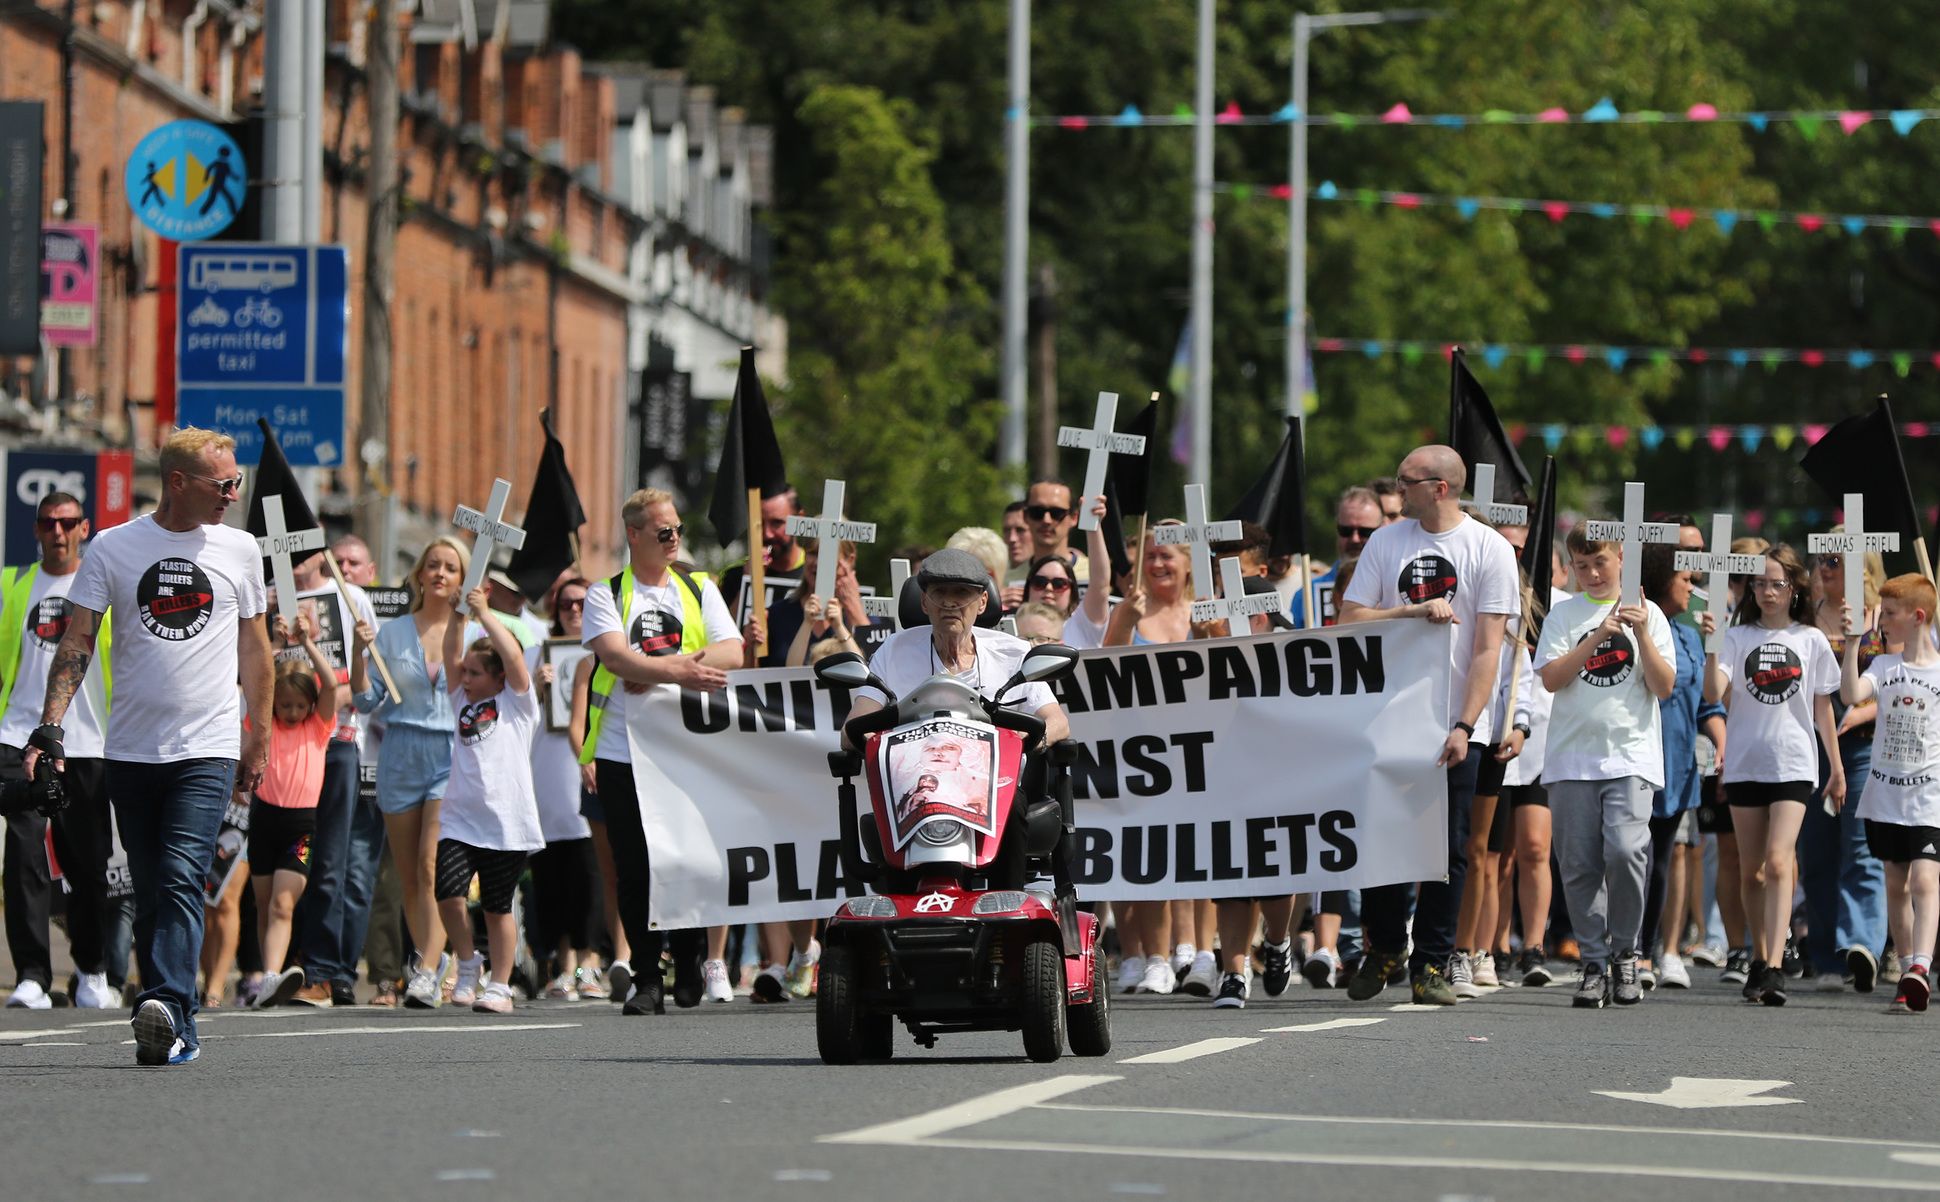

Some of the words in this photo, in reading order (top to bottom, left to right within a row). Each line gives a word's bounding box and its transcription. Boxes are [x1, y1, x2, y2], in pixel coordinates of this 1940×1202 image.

[188, 331, 287, 350] permitted
[218, 352, 256, 371] taxi
[215, 405, 257, 425] Mon
[273, 405, 309, 425] Sat
[1095, 432, 1143, 455] LIVINGSTONE
[1488, 506, 1525, 525] GEDDIS
[792, 518, 819, 538] JOHN
[830, 522, 873, 542] DOWNES
[1155, 529, 1181, 545] CAROL
[1184, 527, 1200, 543] ANN
[1203, 525, 1224, 542] KELLY
[1589, 524, 1626, 542] SEAMUS
[1637, 525, 1665, 543] DUFFY
[273, 533, 305, 555] DUFFY
[1813, 535, 1855, 554] THOMAS
[1865, 535, 1893, 553] FRIEL
[160, 561, 193, 573] PLASTIC
[1677, 555, 1703, 572] PAUL
[1708, 555, 1757, 574] WHITTERS
[158, 573, 193, 586] BULLETS
[157, 586, 174, 597] ARE
[159, 594, 200, 613] KILLERS
[864, 600, 889, 617] BRIAN
[1194, 603, 1217, 621] PETER
[140, 604, 157, 628] BAN
[154, 623, 185, 640] THEM
[186, 608, 211, 637] NOW!
[1759, 654, 1787, 663] BULLETS
[1760, 645, 1787, 654] PLASTIC
[1054, 636, 1385, 713] AMPAIGN
[1758, 662, 1772, 671] ARE
[1587, 673, 1610, 686] THEM
[1758, 691, 1781, 704] THEM
[896, 724, 934, 740] THEY
[936, 722, 987, 737] SHOOT
[904, 728, 978, 743] CHILDREN
[1871, 768, 1887, 782] NOT
[1888, 775, 1932, 787] BULLETS
[1074, 809, 1358, 885] BULLETS
